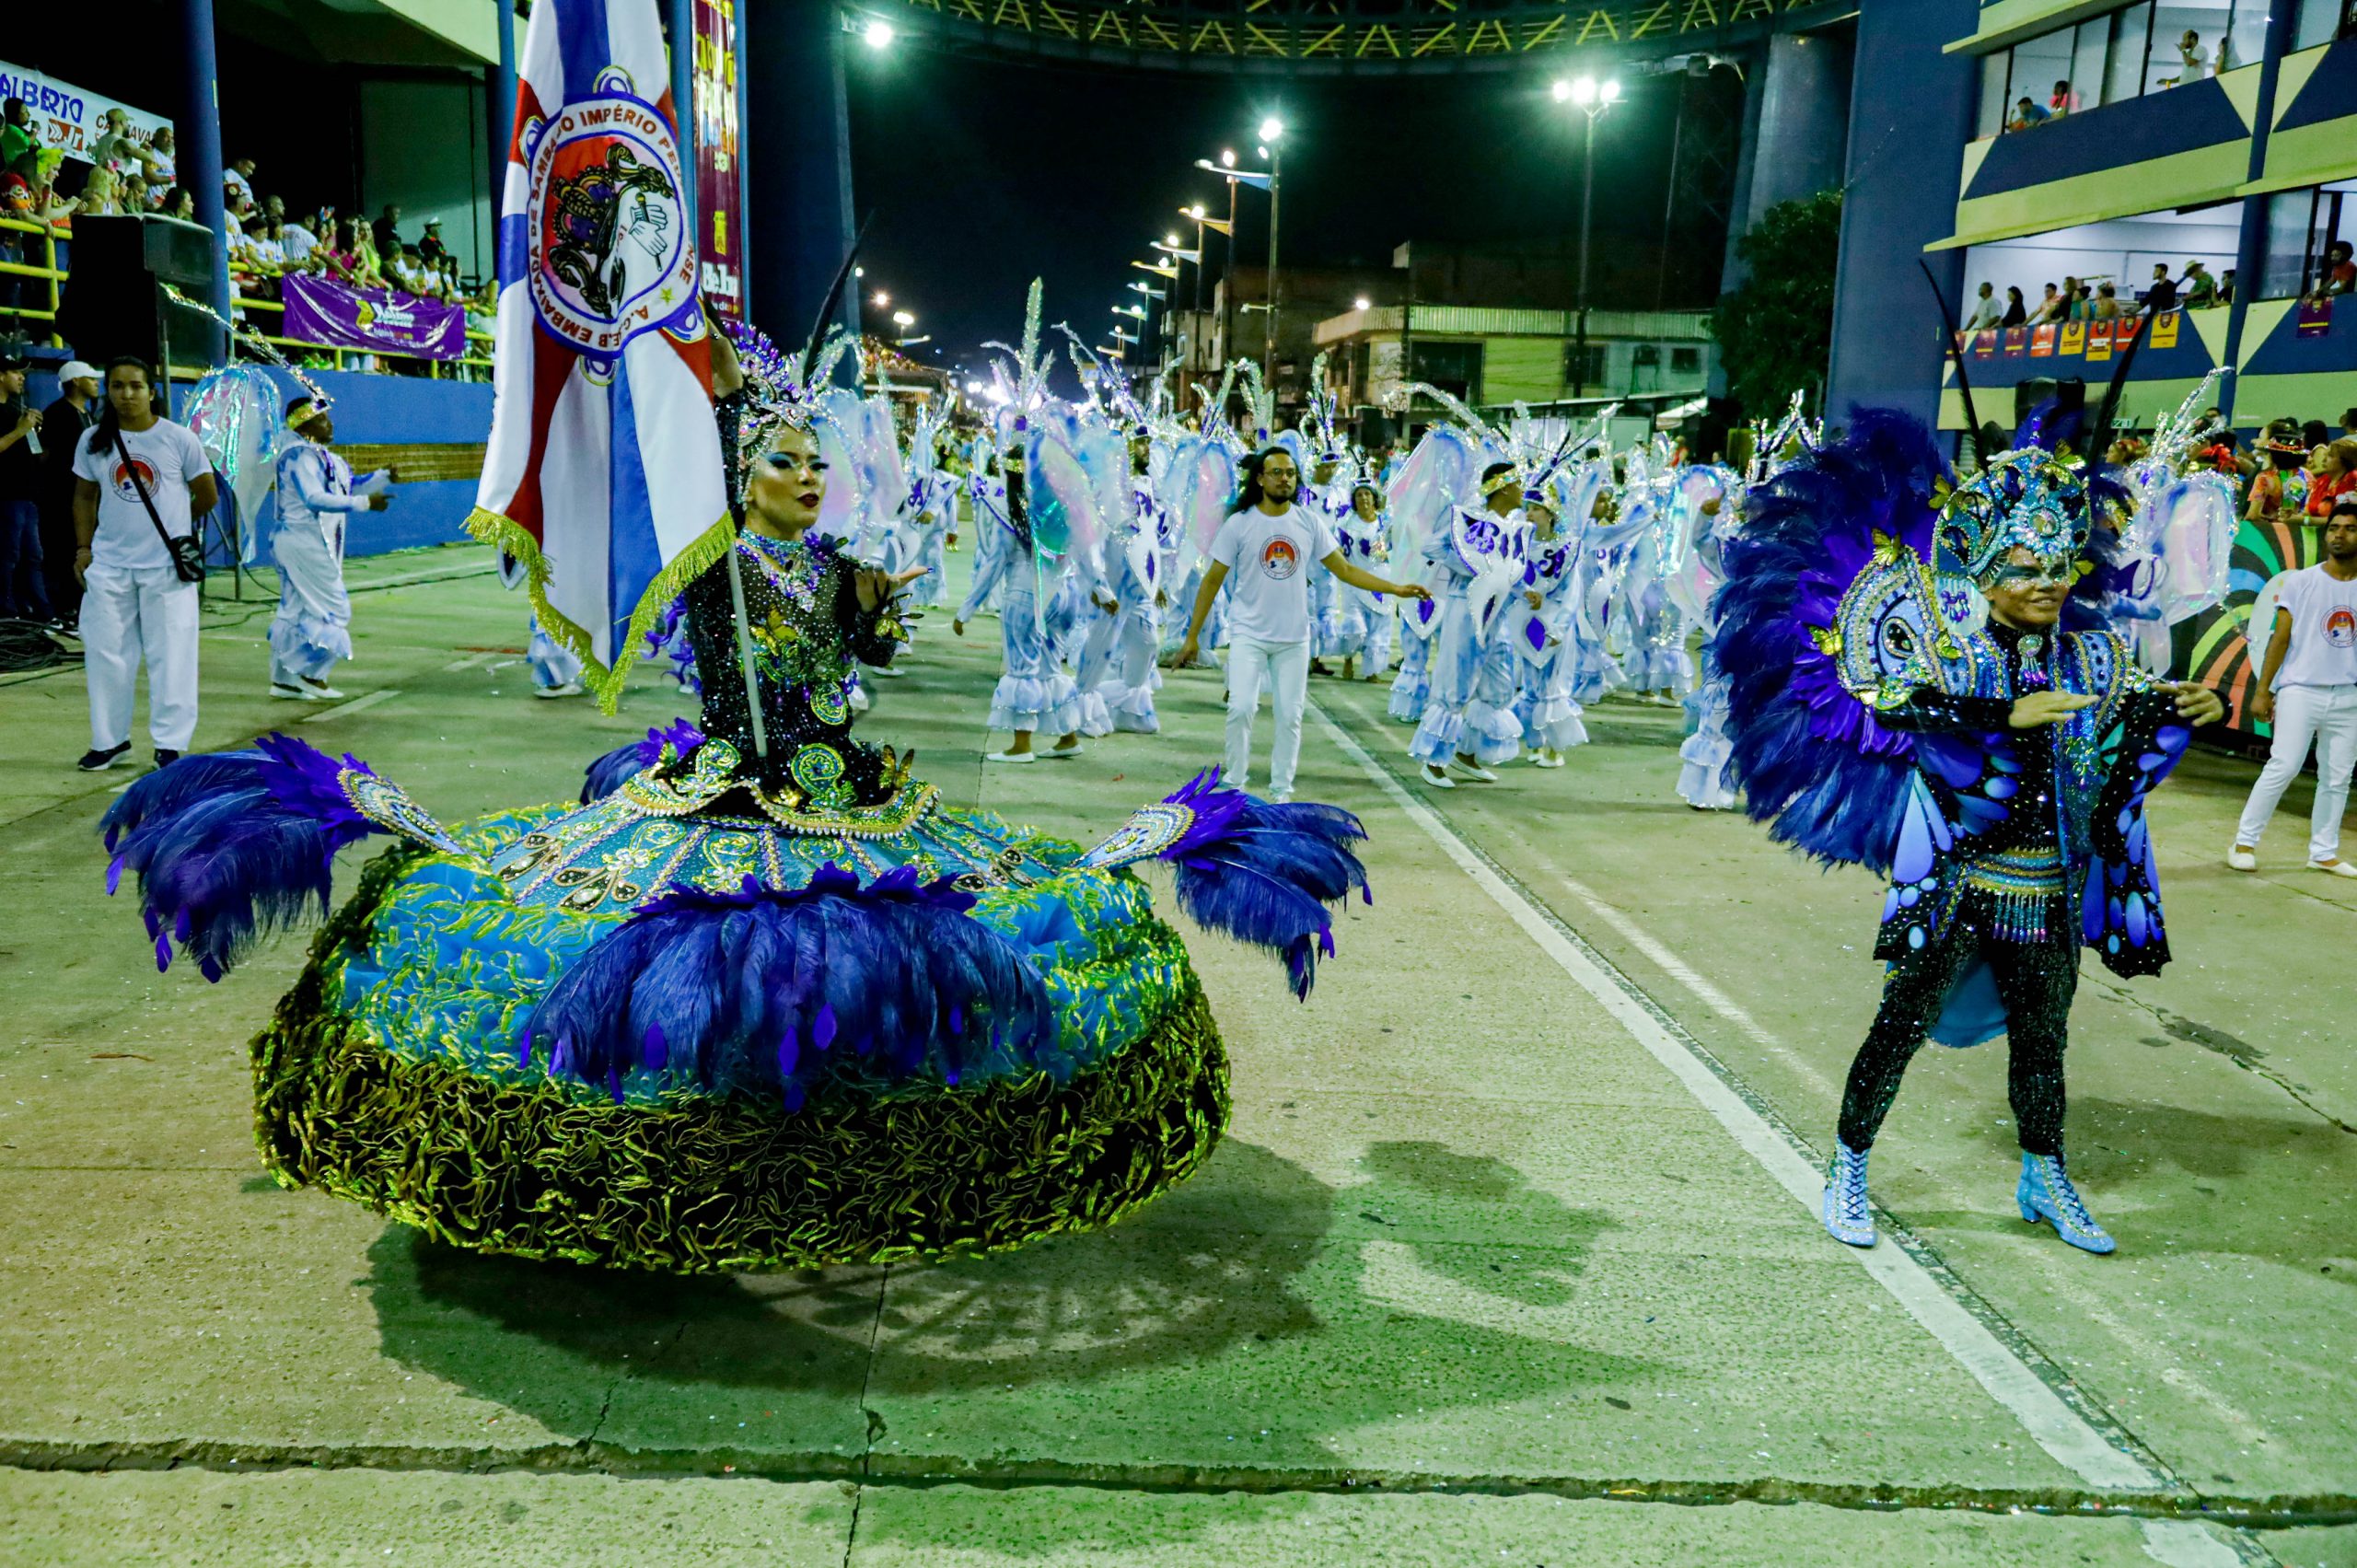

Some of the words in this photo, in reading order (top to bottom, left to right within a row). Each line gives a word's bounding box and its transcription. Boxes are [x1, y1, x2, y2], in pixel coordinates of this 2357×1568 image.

[0, 73, 84, 124] ALBERTO
[529, 210, 538, 237] DE
[579, 104, 656, 134] IMPÉRIO
